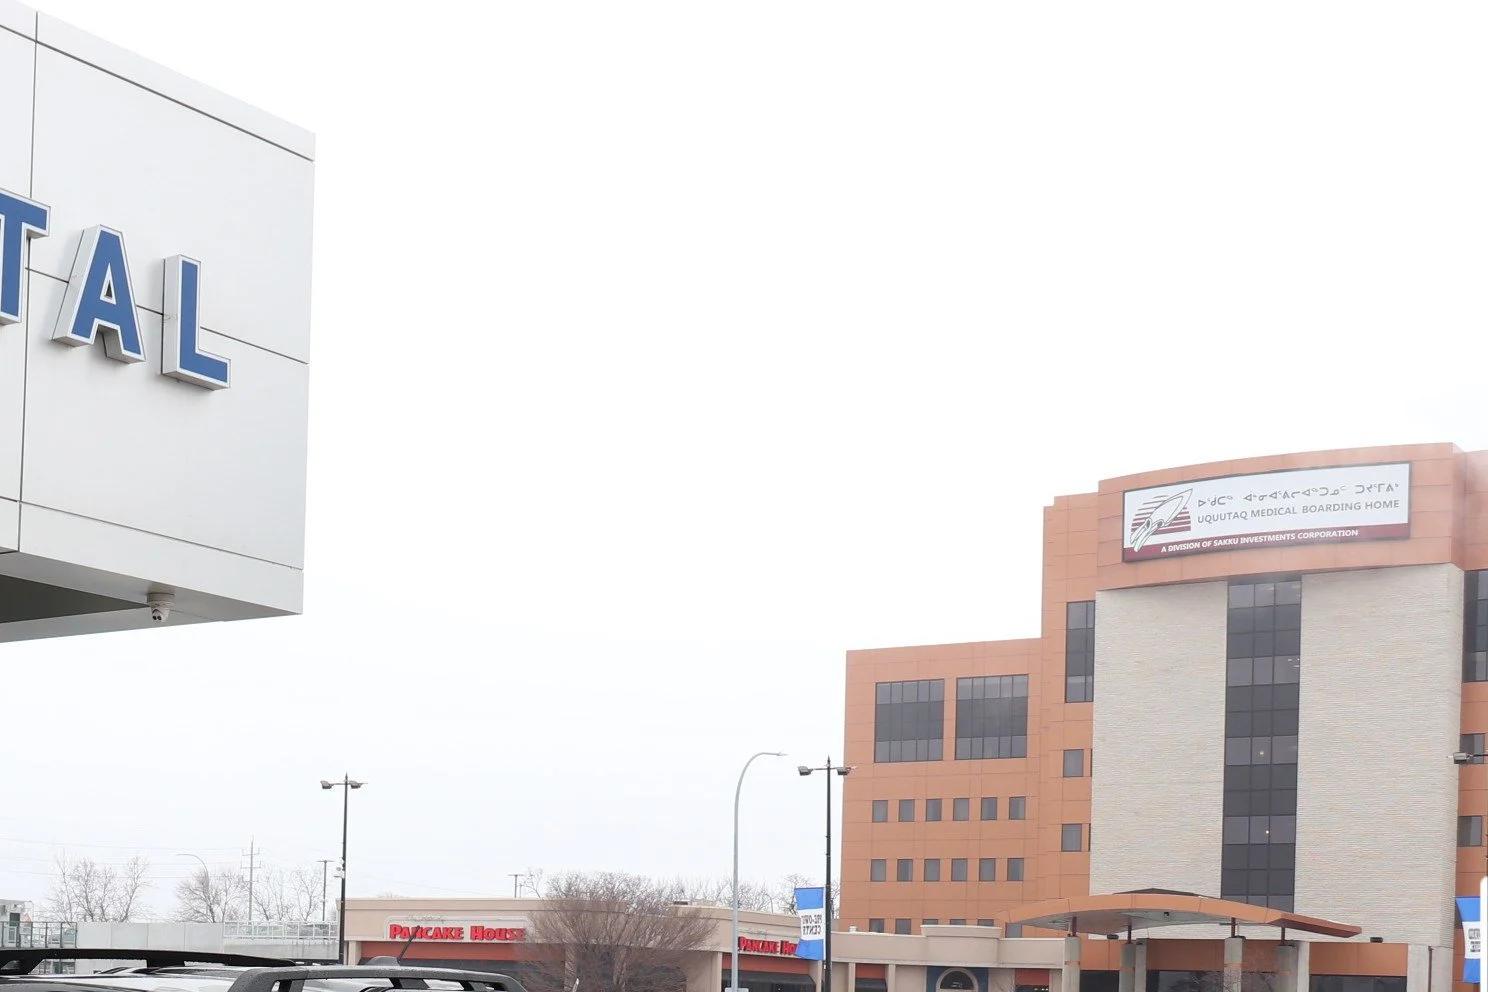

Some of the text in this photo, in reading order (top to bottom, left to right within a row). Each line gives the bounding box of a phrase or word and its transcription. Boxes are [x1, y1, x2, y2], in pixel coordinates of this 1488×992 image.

[1197, 499, 1400, 525] UQUUTAQ MEDICAL BOARDING HOME
[1168, 542, 1200, 552] DIVISION
[1201, 540, 1213, 549] OF
[1213, 538, 1239, 548] SAKKU
[1240, 533, 1296, 544] INVESTMENTS
[1297, 529, 1359, 541] CORPORATION
[389, 924, 526, 941] PANCAKE HOUSE
[738, 936, 779, 954] PANCAKE
